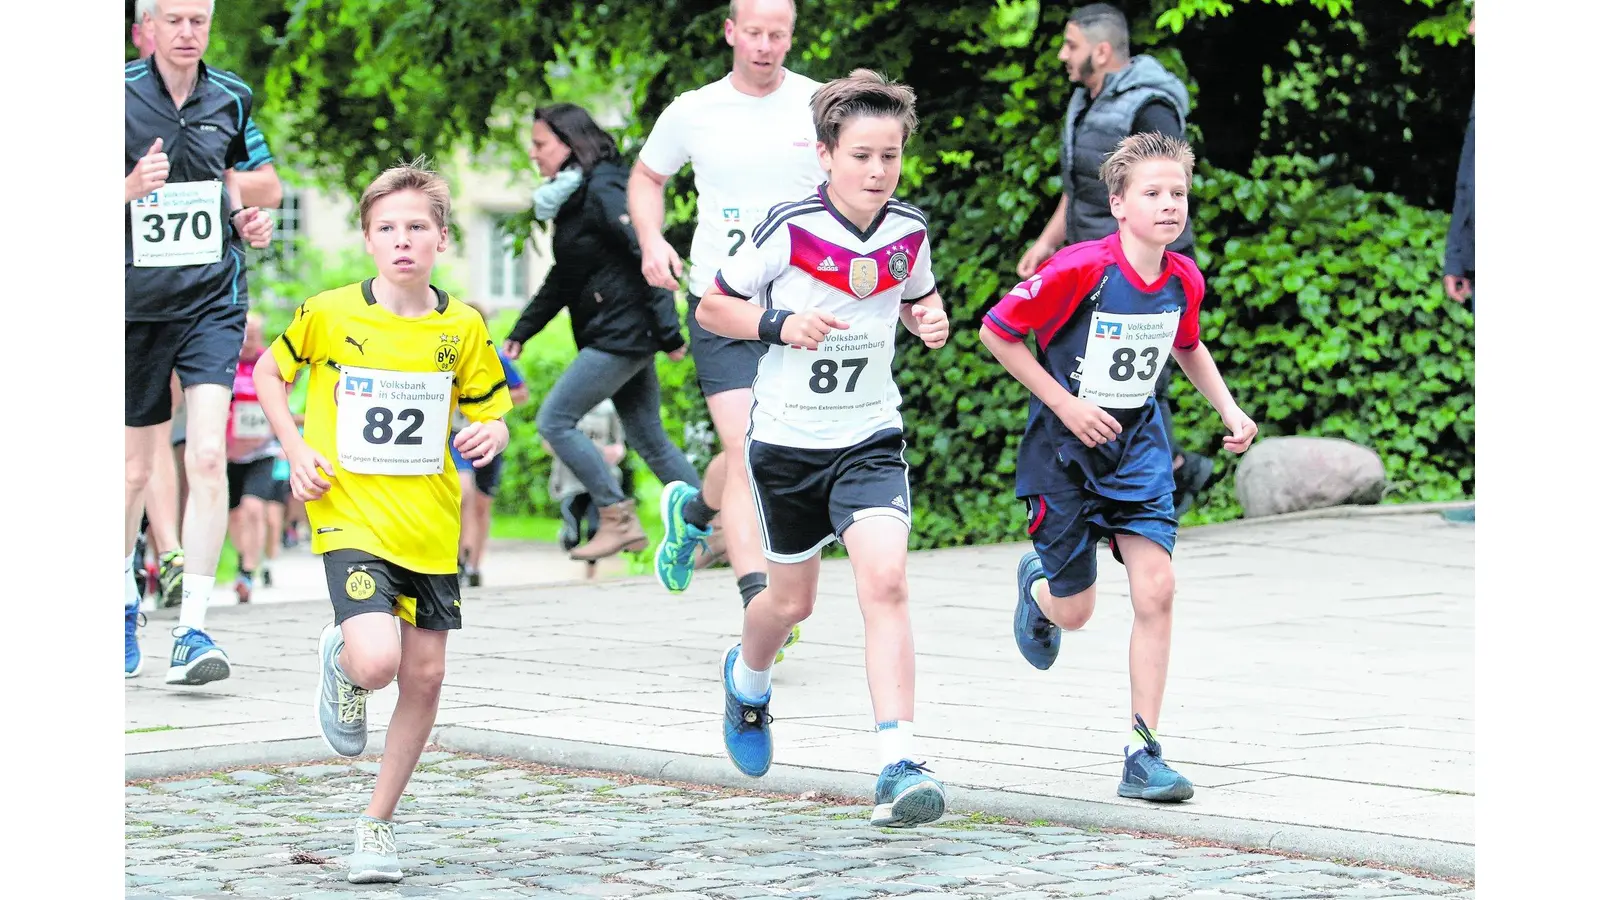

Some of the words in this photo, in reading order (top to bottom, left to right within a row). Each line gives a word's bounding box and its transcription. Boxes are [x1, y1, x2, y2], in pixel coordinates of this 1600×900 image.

[142, 210, 212, 243] 370
[1127, 322, 1164, 331] Volksbank
[824, 332, 869, 342] Volksbank
[1125, 332, 1134, 341] in
[835, 340, 885, 352] Schaumburg
[437, 347, 456, 364] BVB
[1108, 346, 1160, 382] 83
[808, 357, 869, 394] 87
[380, 380, 427, 390] Volksbank
[378, 391, 388, 400] in
[391, 391, 445, 402] Schaumburg
[1084, 387, 1098, 396] Lauf
[1097, 391, 1116, 399] gegen
[799, 403, 818, 411] gegen
[818, 403, 855, 411] Extremismus
[362, 406, 425, 445] 82
[352, 455, 371, 463] gegen
[372, 456, 410, 464] Extremismus
[421, 456, 440, 464] Gewalt
[351, 575, 372, 592] BVB
